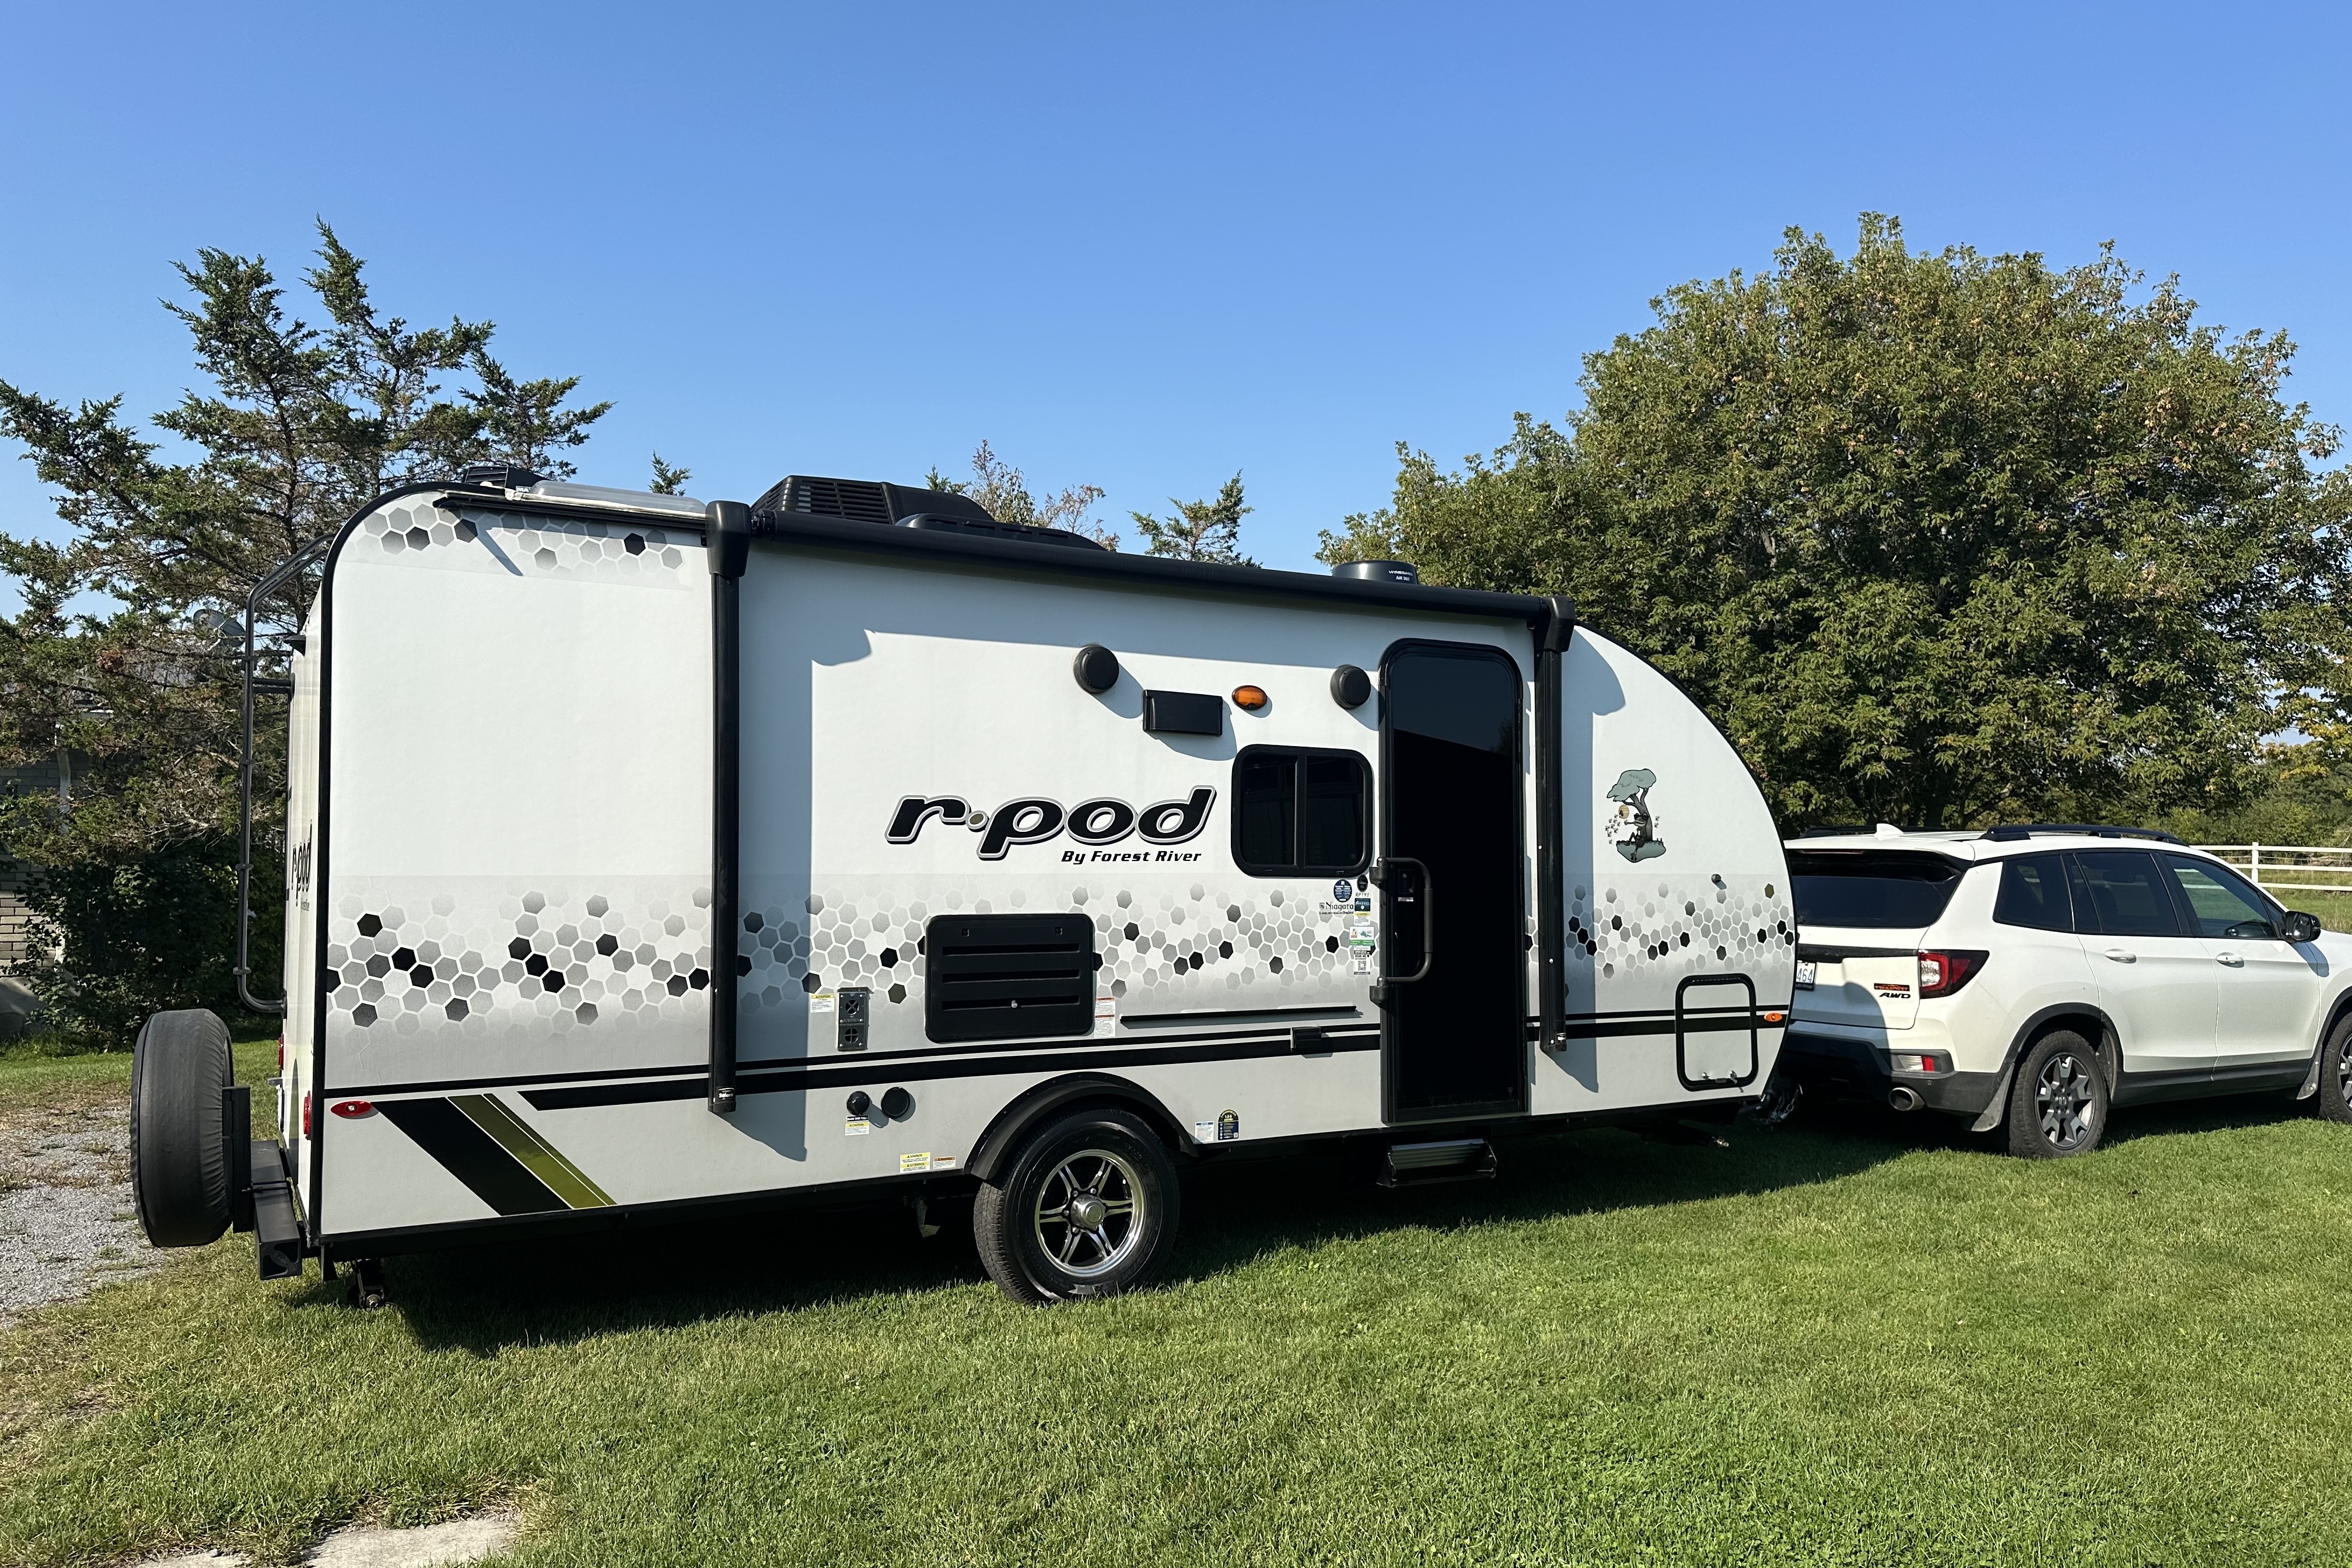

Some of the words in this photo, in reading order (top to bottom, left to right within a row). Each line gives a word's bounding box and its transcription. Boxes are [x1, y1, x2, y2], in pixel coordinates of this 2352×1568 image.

[1061, 851, 1085, 864] By
[1090, 850, 1151, 862] Forest
[1155, 850, 1202, 862] River
[1325, 901, 1354, 912] Niagara
[1797, 968, 1813, 983] 464
